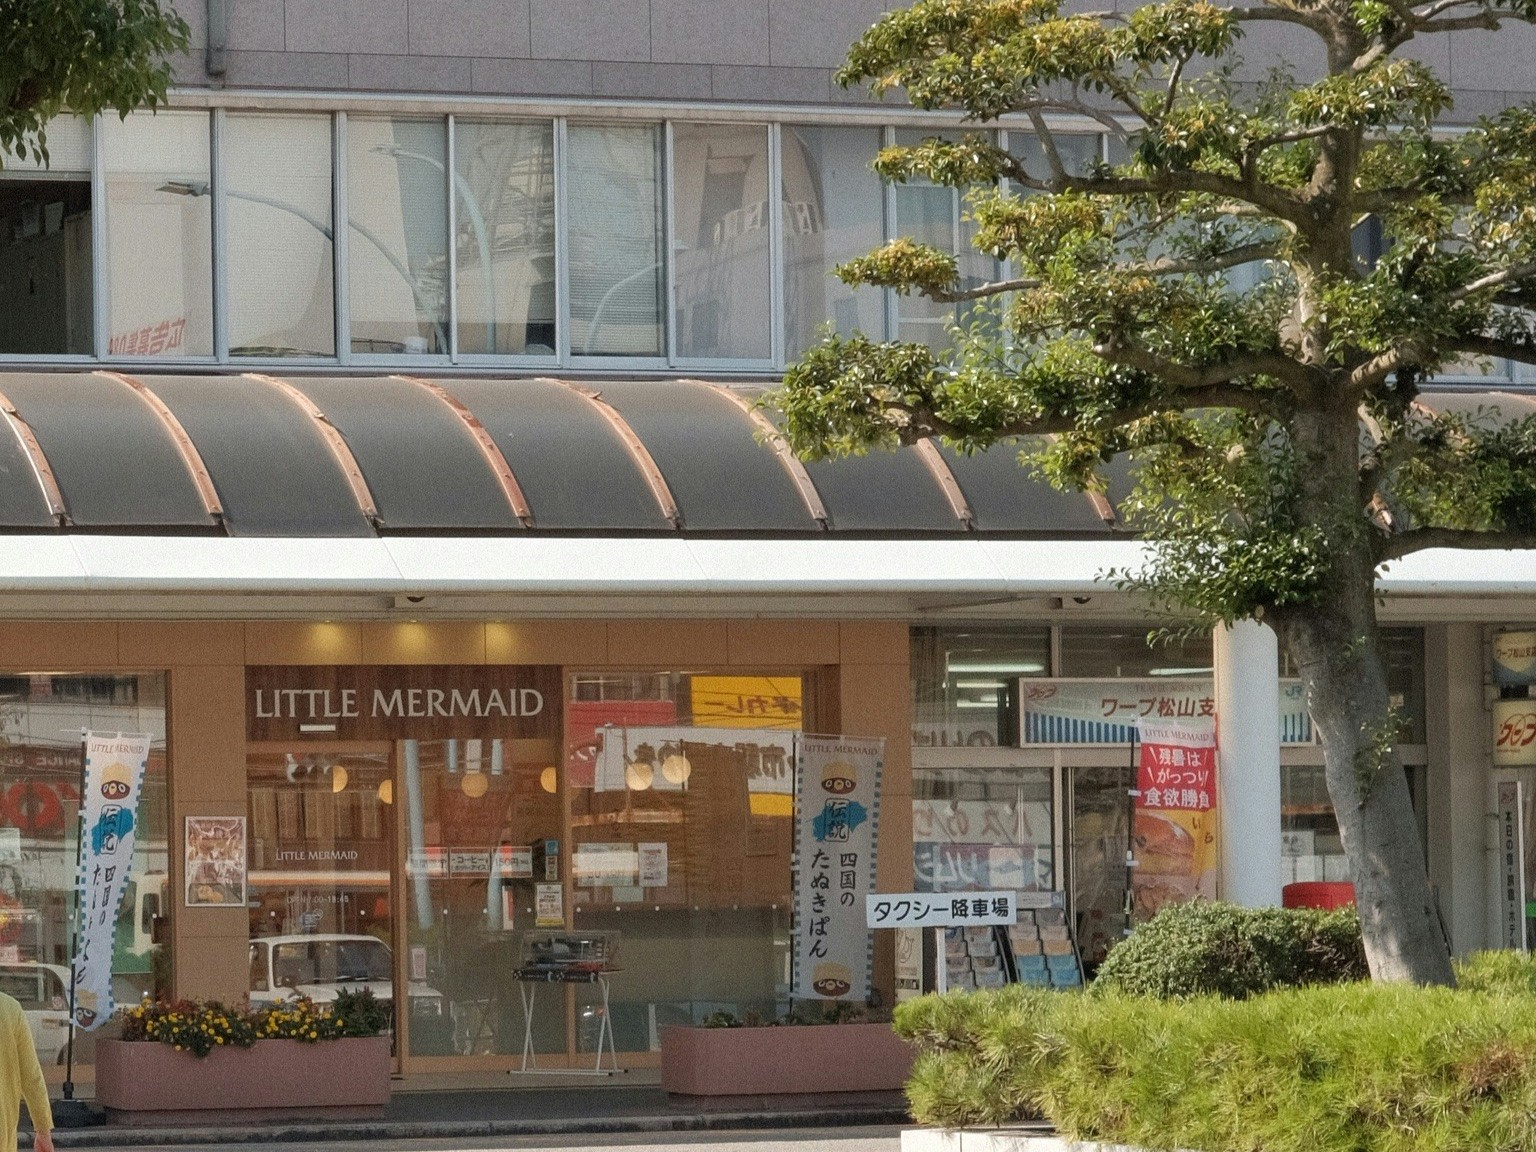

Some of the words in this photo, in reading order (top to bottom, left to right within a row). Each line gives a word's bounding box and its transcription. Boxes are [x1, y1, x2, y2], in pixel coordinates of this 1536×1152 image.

[1284, 685, 1303, 697] JR
[255, 688, 359, 718] LITTLE
[371, 688, 544, 718] MERMAID
[804, 743, 832, 756] LITTLE
[833, 744, 879, 756] MERMAID
[1144, 787, 1210, 809] 食欲勝負
[275, 849, 306, 861] LITTLE
[308, 850, 358, 861] MERMAID
[840, 852, 858, 906] 四国の
[808, 848, 831, 959] たぬきぱん
[873, 897, 1010, 922] タクシー降車場
